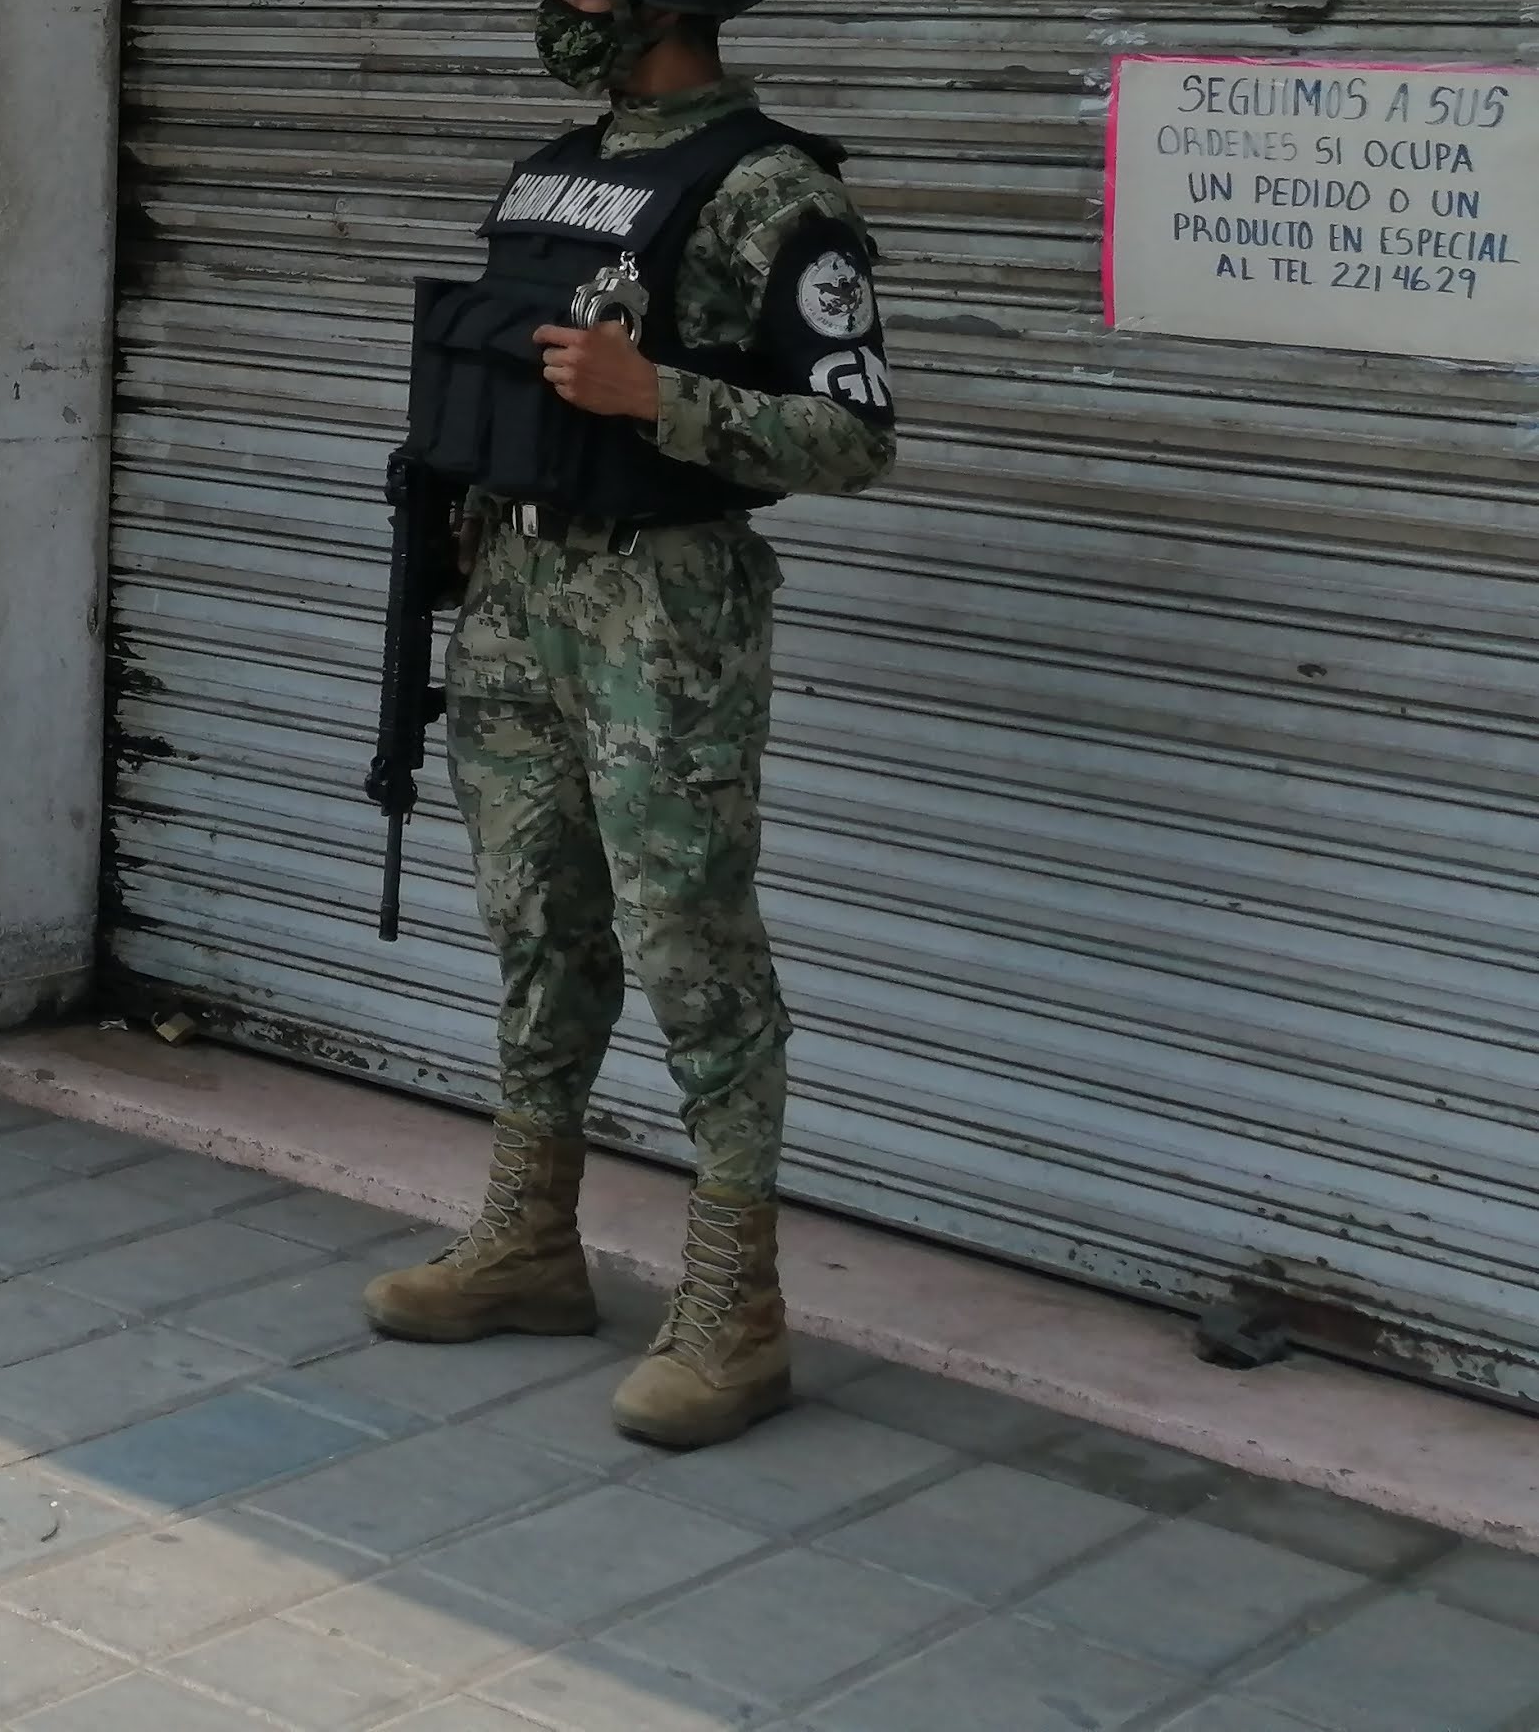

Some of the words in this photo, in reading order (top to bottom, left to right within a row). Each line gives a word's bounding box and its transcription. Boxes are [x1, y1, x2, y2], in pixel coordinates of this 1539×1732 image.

[1177, 73, 1370, 120] SEGUIMOS
[1384, 81, 1411, 123] A
[1423, 84, 1510, 128] SUS
[1157, 123, 1299, 161] ORDENES
[1314, 135, 1342, 166] SI
[1363, 138, 1475, 174] OCUPA
[496, 172, 571, 223] GUARDIA
[545, 175, 655, 237] NACIONAL
[1188, 171, 1233, 204] UN
[1254, 174, 1371, 211] PEDIDO
[1389, 187, 1410, 214] O
[1431, 189, 1480, 219] UN
[1173, 212, 1314, 250] PRODUCTO
[1328, 223, 1363, 254] EN
[1379, 225, 1521, 265] ESPECIAL
[1215, 253, 1255, 281] AL
[1268, 255, 1317, 286] TEL
[808, 345, 889, 408] GN
